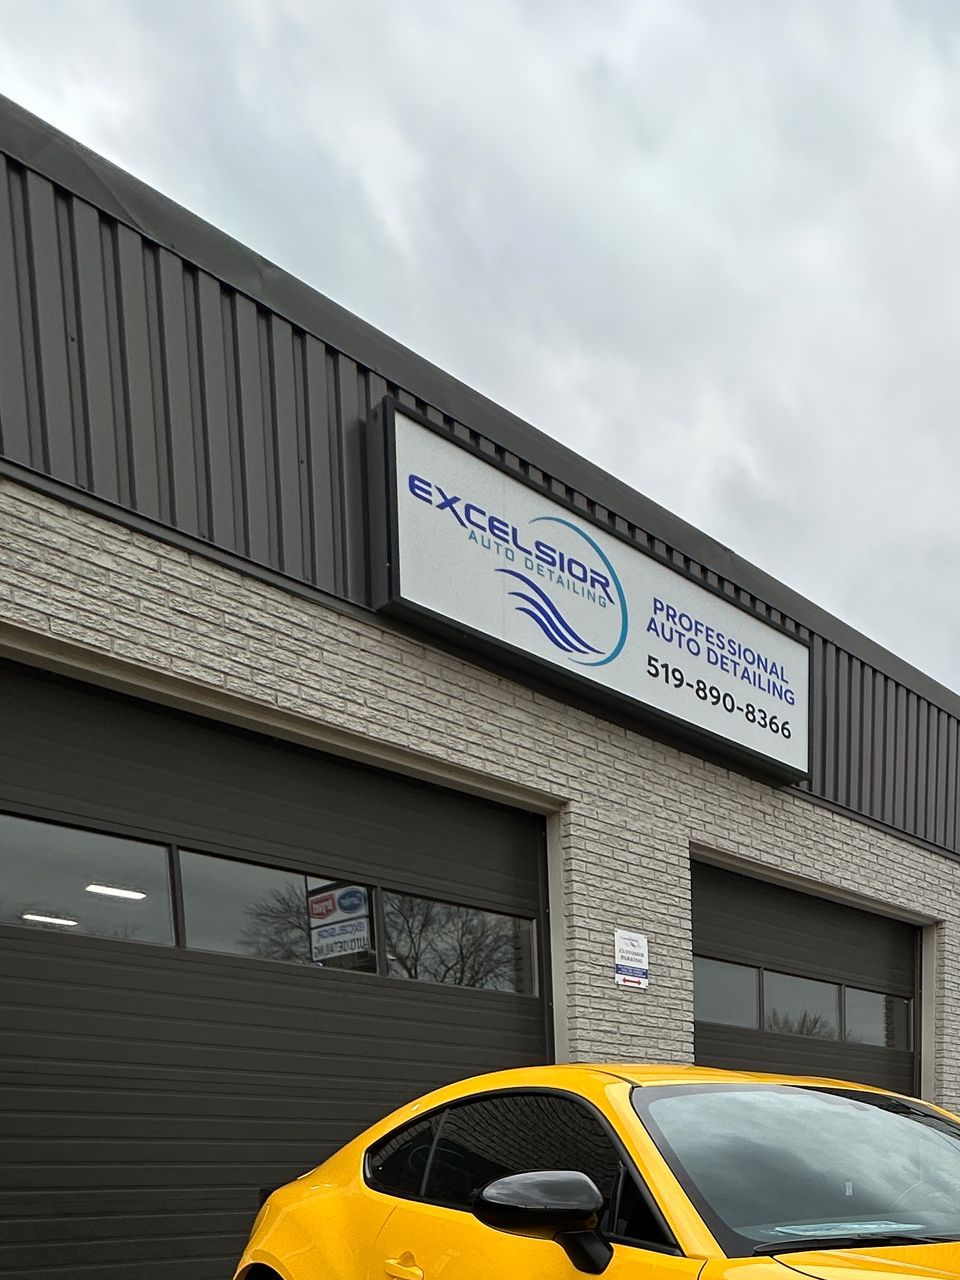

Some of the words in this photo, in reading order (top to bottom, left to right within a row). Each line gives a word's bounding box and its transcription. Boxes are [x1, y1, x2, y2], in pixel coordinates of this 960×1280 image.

[408, 474, 615, 605] EXCELSIOR
[468, 530, 515, 562] AUTO
[524, 556, 607, 608] DETAILING
[646, 617, 701, 656] AUTO
[707, 647, 795, 705] DETAILING
[653, 597, 789, 684] PROFESSIONAL
[647, 655, 791, 739] 519-890-8366
